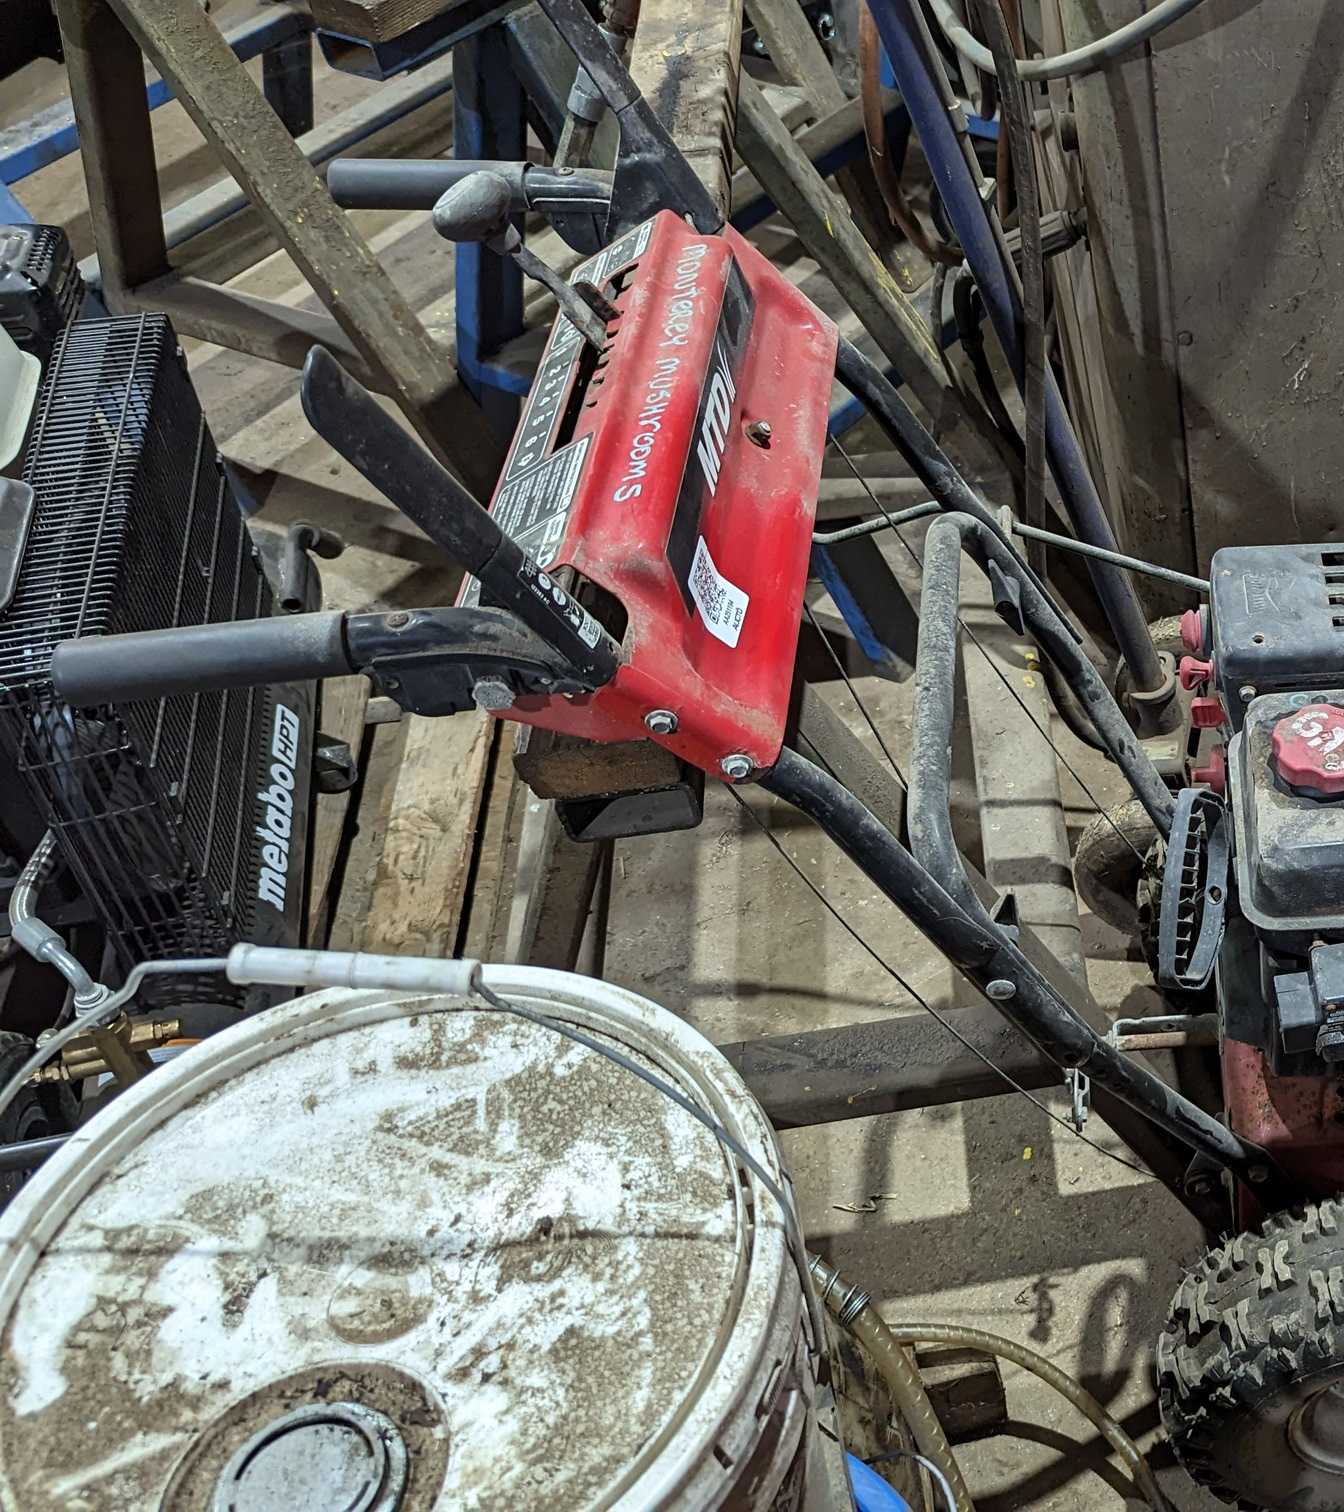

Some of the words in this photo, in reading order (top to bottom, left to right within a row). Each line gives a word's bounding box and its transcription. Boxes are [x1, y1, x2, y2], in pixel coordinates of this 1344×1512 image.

[697, 371, 731, 497] MTD
[256, 763, 296, 912] metabo
[278, 709, 296, 759] HPT
